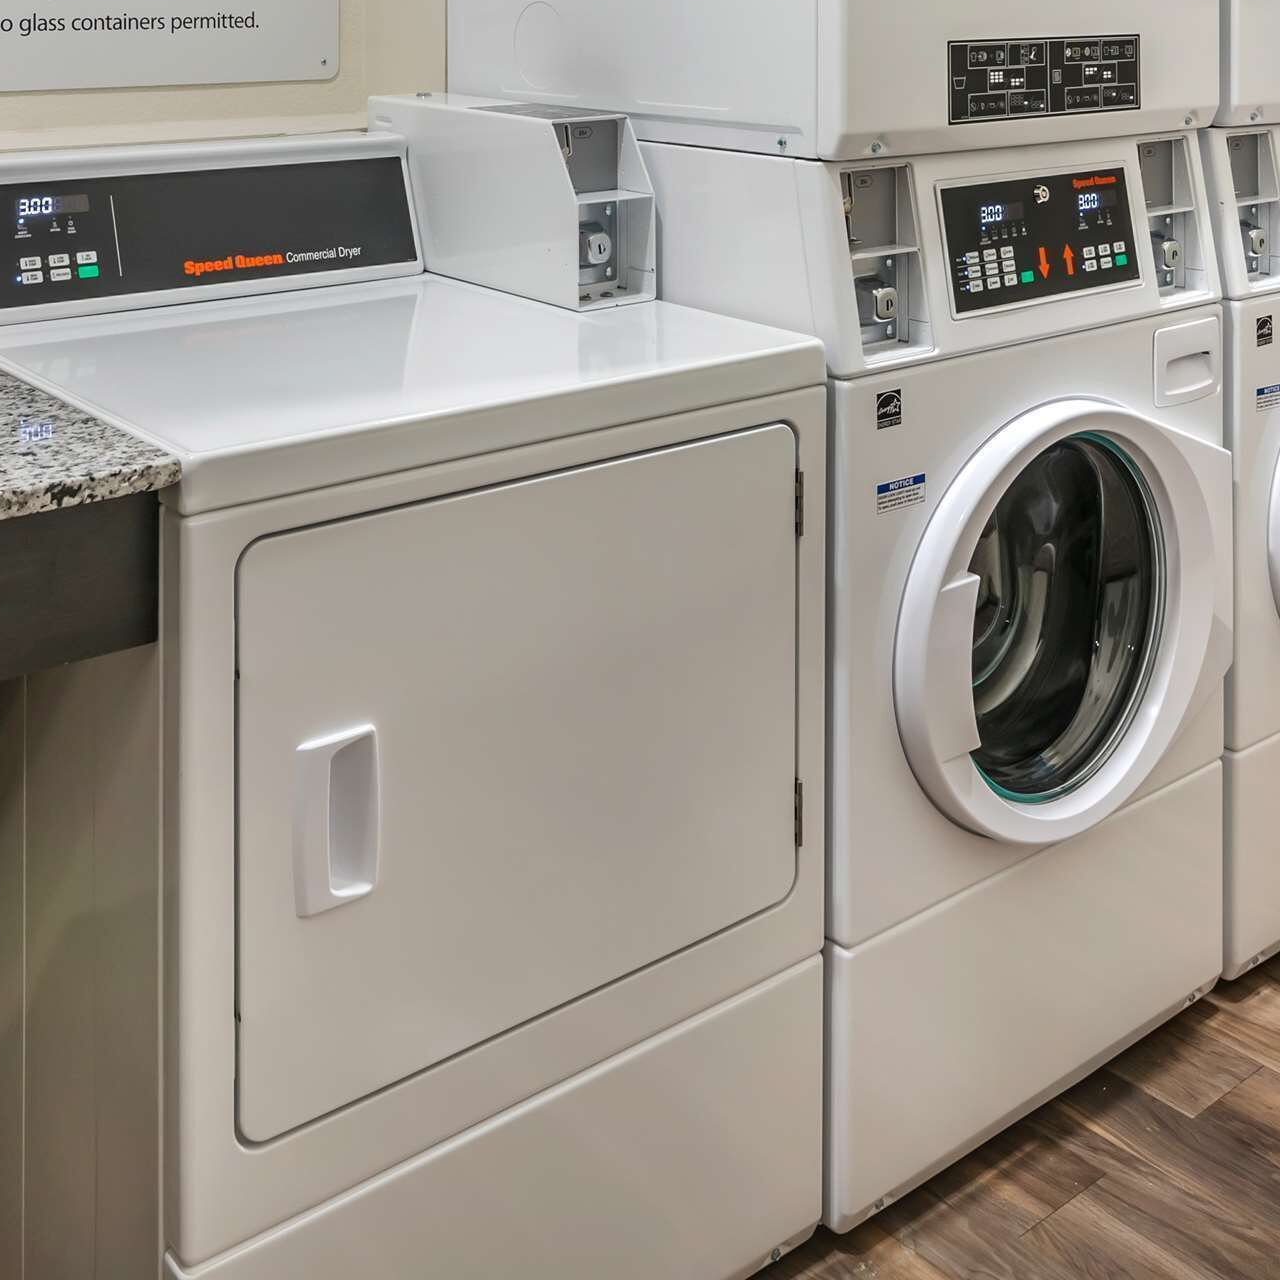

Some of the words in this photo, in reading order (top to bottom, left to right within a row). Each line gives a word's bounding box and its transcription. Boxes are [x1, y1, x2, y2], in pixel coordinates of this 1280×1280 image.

[18, 12, 66, 37] glass
[71, 12, 166, 32] containers
[171, 10, 260, 35] permitted.
[19, 197, 53, 216] 3.00
[183, 256, 233, 276] Speed
[235, 253, 284, 269] Queen
[285, 247, 337, 264] Commercial
[338, 246, 362, 260] Dryer
[889, 478, 914, 491] NOTICE
